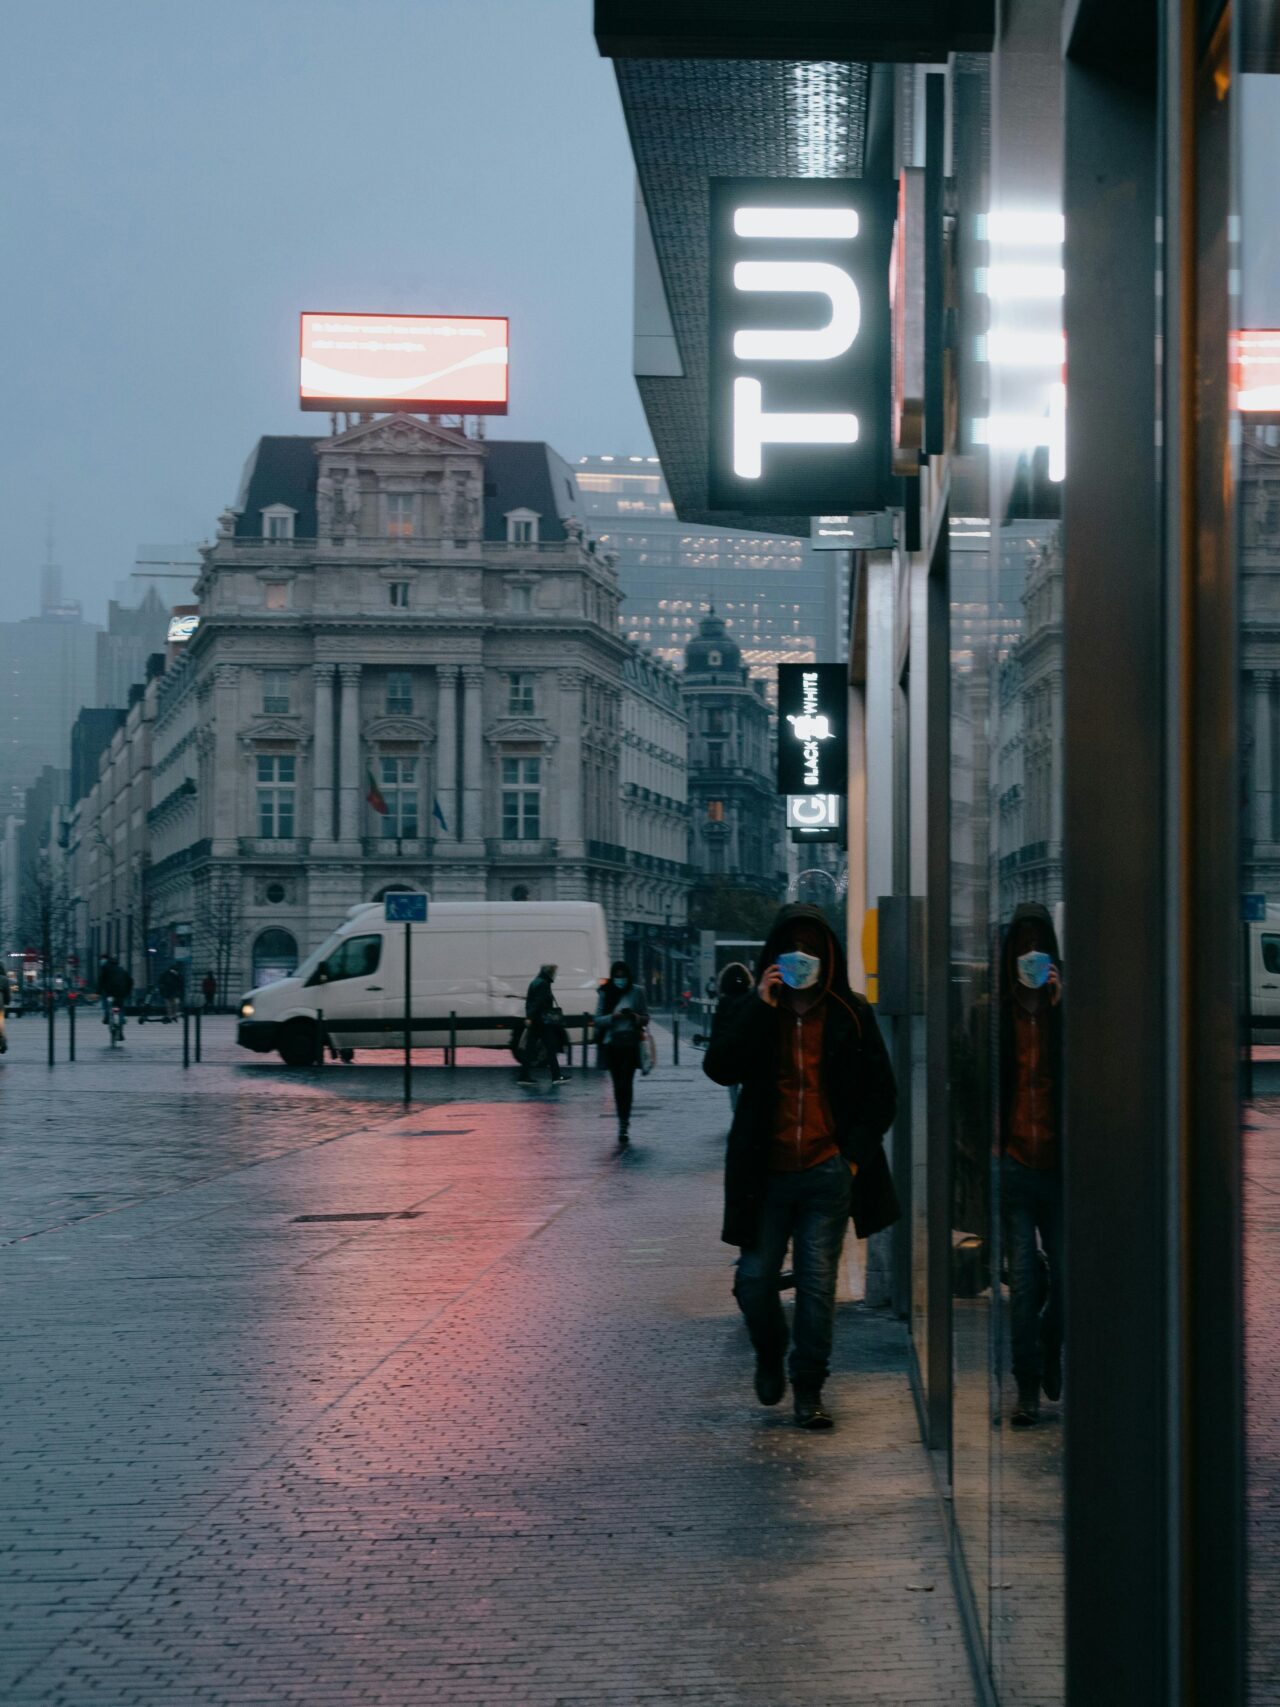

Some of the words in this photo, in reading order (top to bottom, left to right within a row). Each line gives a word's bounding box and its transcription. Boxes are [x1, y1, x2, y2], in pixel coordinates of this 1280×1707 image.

[733, 207, 861, 479] TUI
[802, 672, 818, 714] WHITE
[803, 741, 819, 786] BLACK
